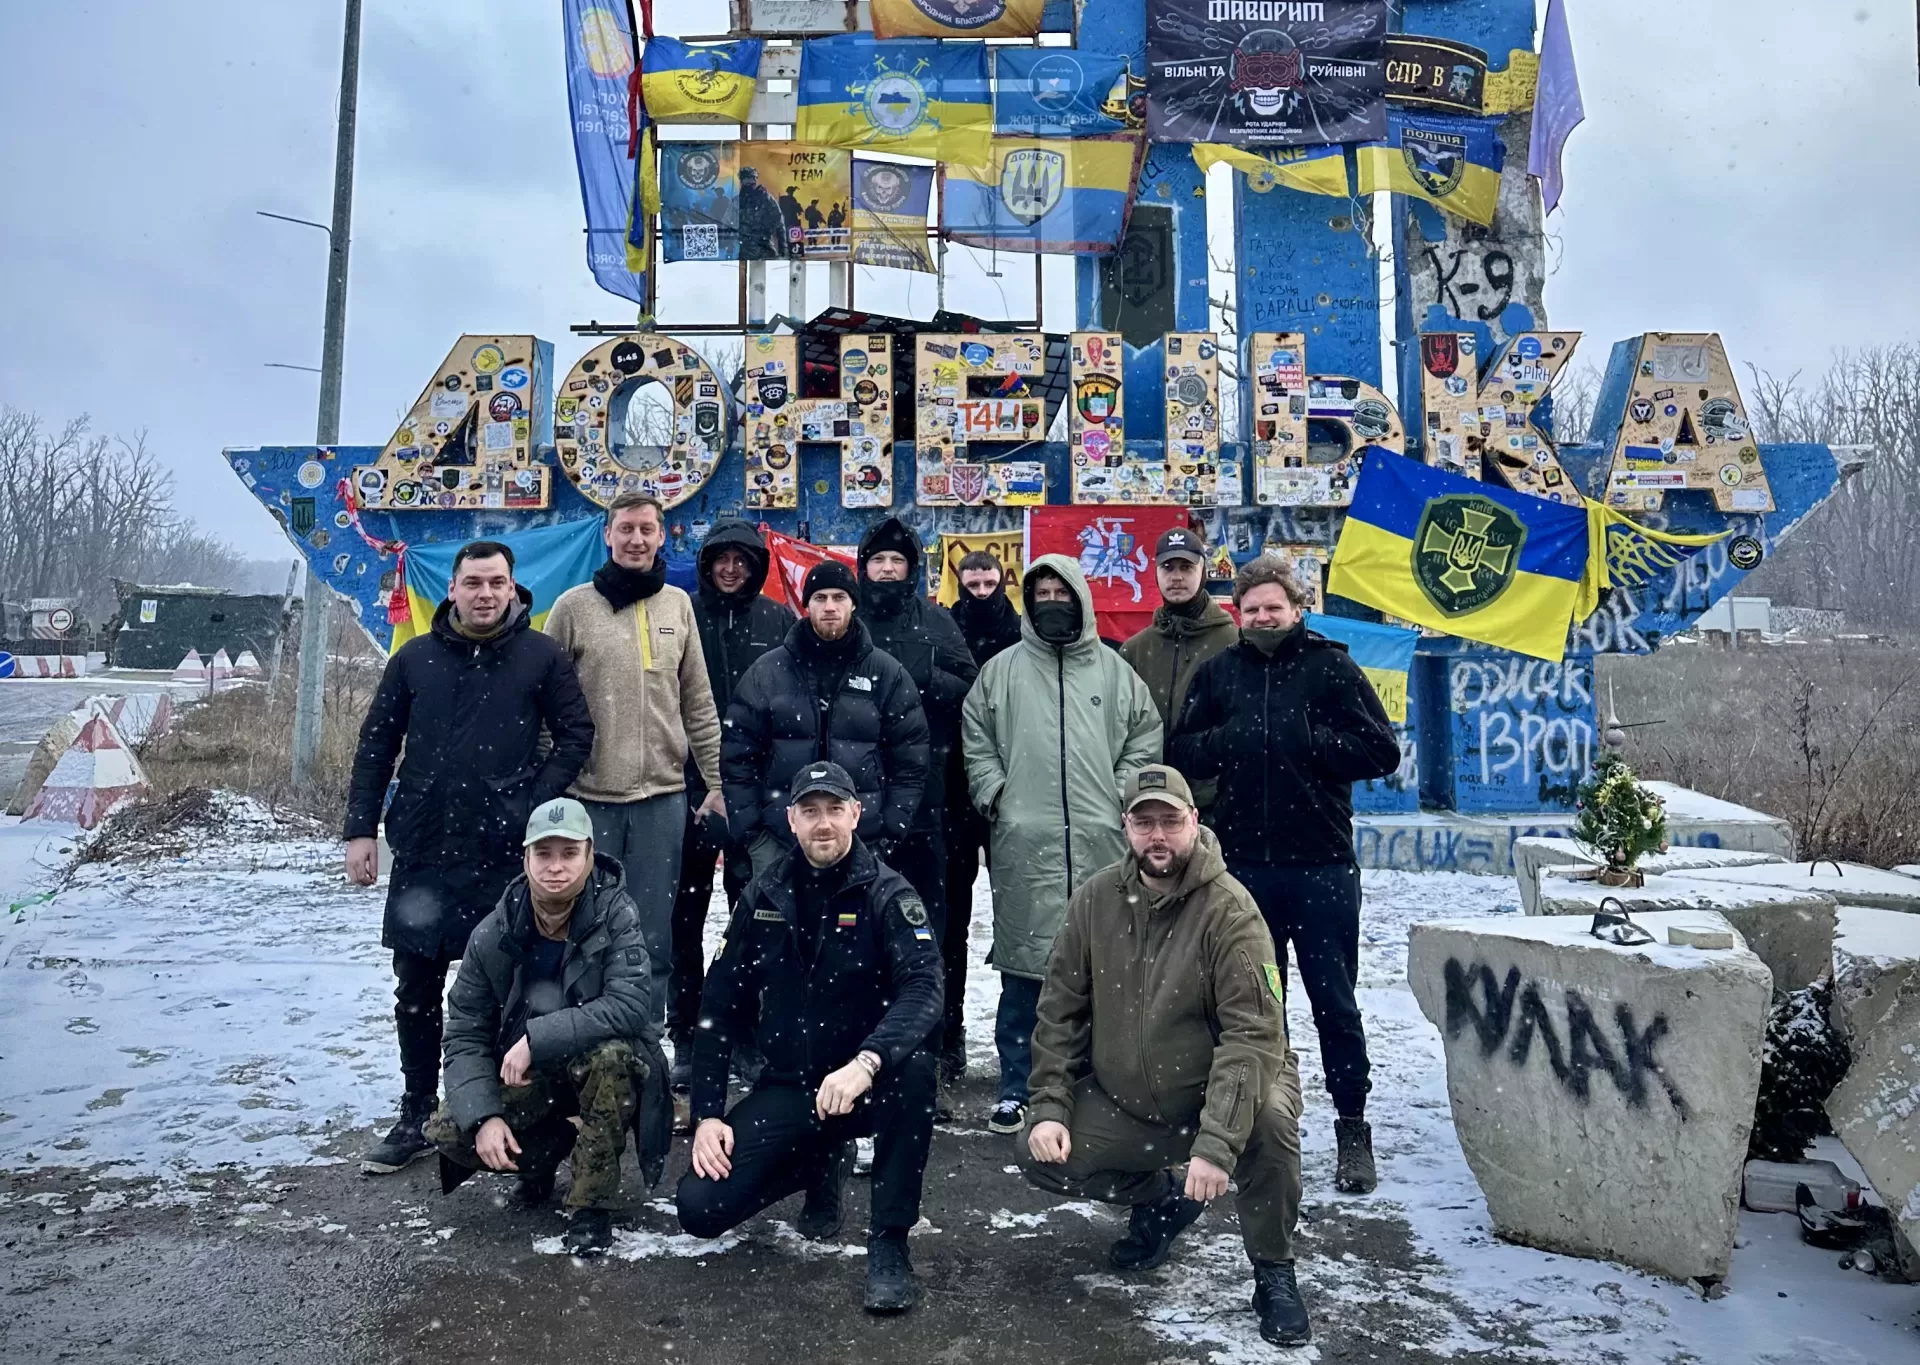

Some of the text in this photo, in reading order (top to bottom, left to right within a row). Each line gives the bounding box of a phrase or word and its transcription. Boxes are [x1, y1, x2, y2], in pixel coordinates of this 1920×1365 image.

[1164, 65, 1226, 77] ВІЛЬНІ ТА
[1309, 65, 1366, 77] РУЙНІВНІ
[1009, 113, 1107, 127] ЖМЕНЯ ДОБРА
[1405, 128, 1461, 145] ПОЛІЦІЯ
[787, 152, 827, 165] JOKER
[1009, 153, 1059, 165] ДОНБАС
[791, 169, 824, 182] TEAM
[1255, 296, 1316, 321] ВАРАШ
[1014, 362, 1032, 371] UAI
[352, 331, 1777, 516] ДОНЕЦЬКА
[957, 401, 1021, 433] T4U
[1468, 500, 1495, 515] КИЇВ
